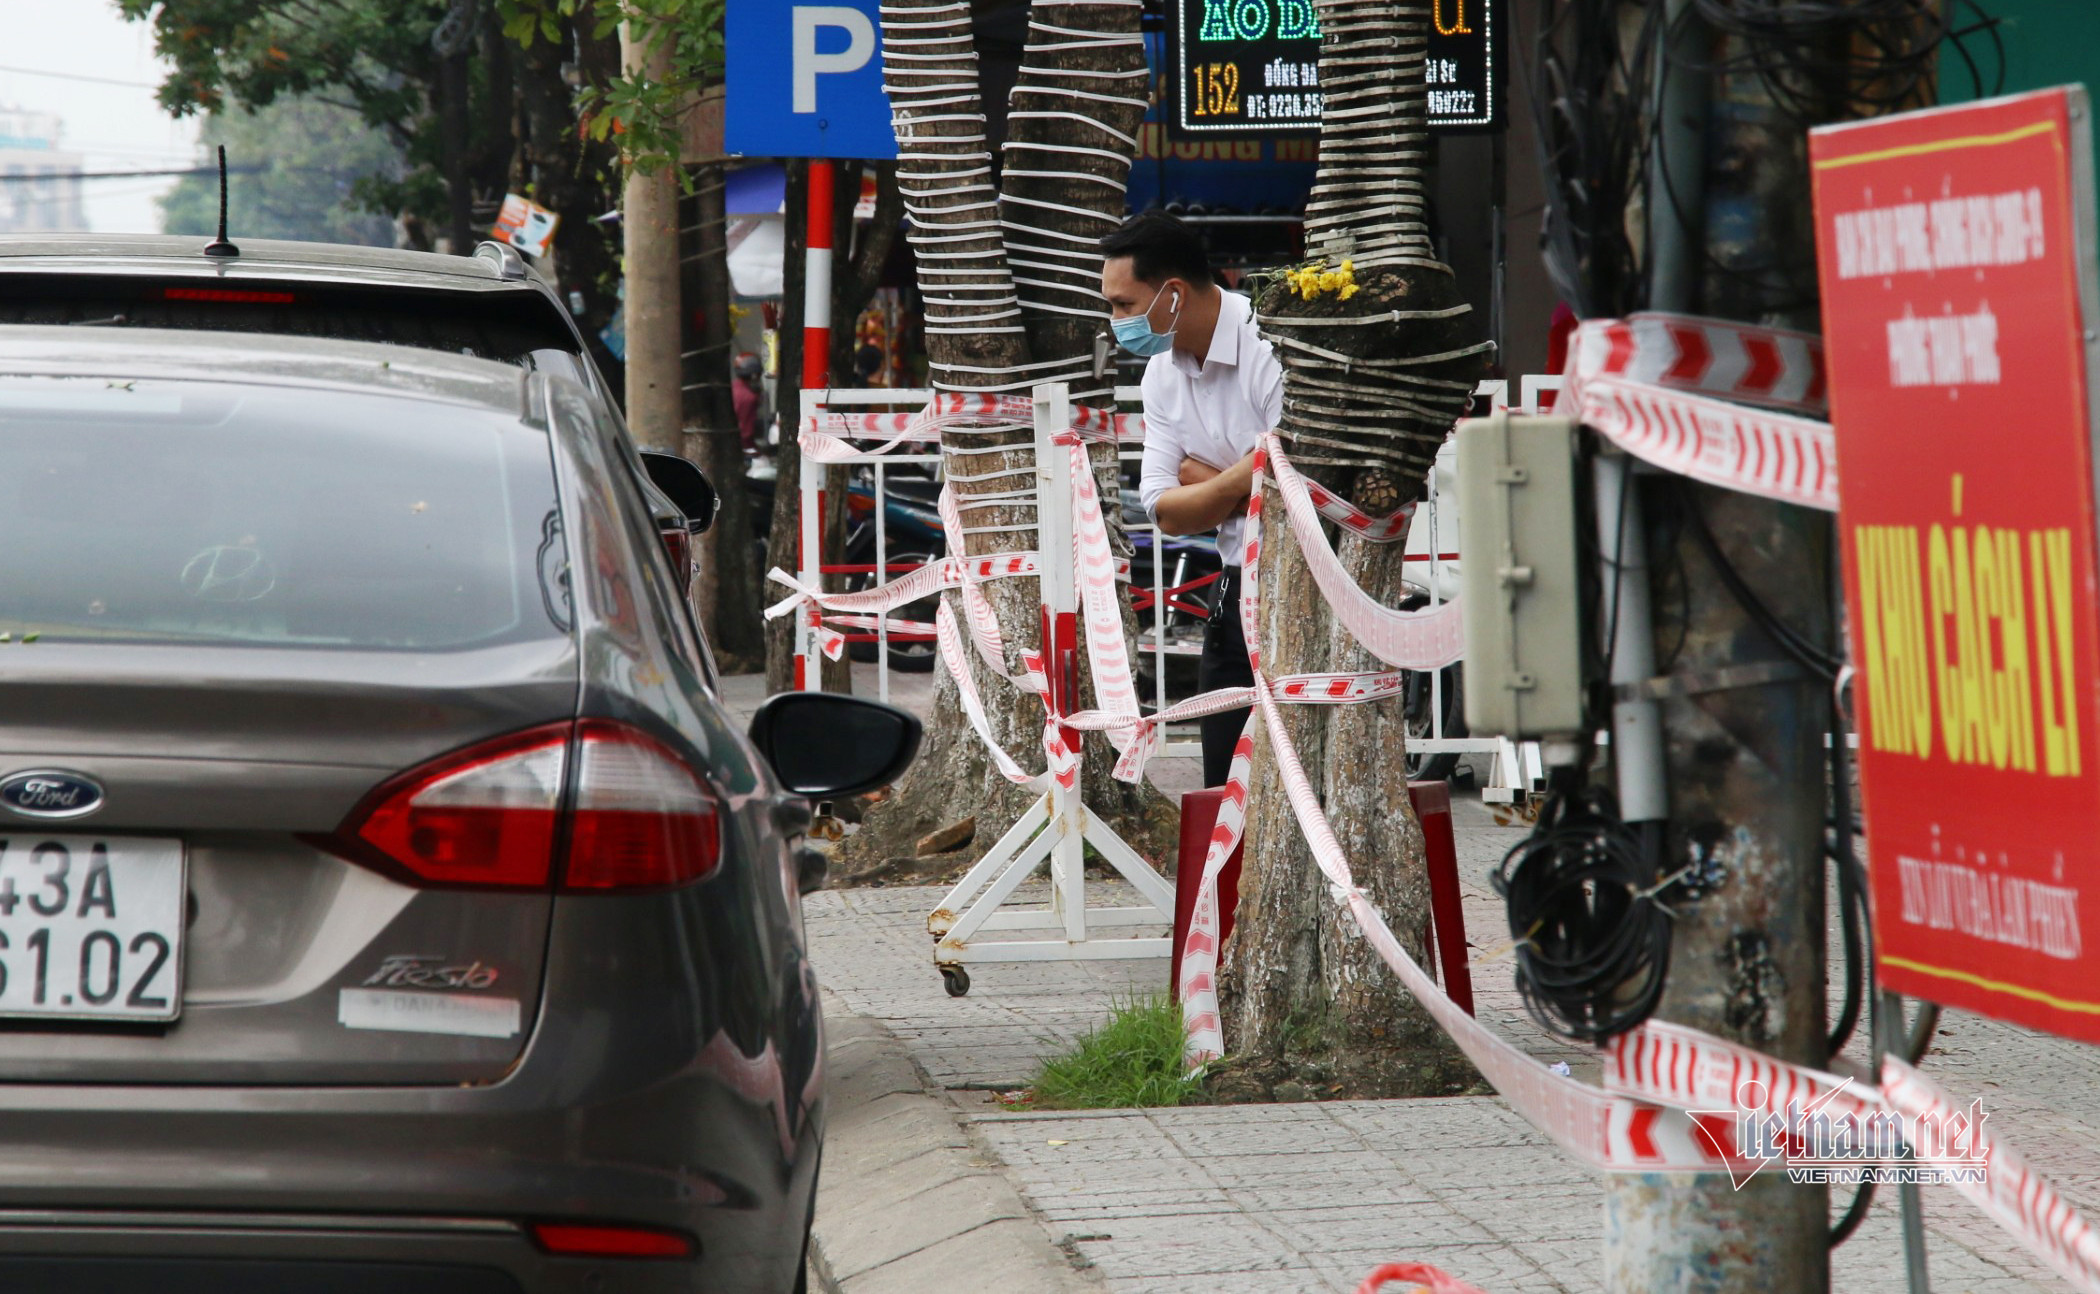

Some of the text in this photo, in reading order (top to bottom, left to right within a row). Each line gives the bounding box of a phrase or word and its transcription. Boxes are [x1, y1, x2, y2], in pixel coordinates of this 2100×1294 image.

[792, 6, 875, 113] P
[1194, 62, 1239, 116] 152
[1855, 473, 2081, 777] KHU CÁCH LY
[18, 778, 79, 806] Ford
[0, 928, 170, 1009] 1.02
